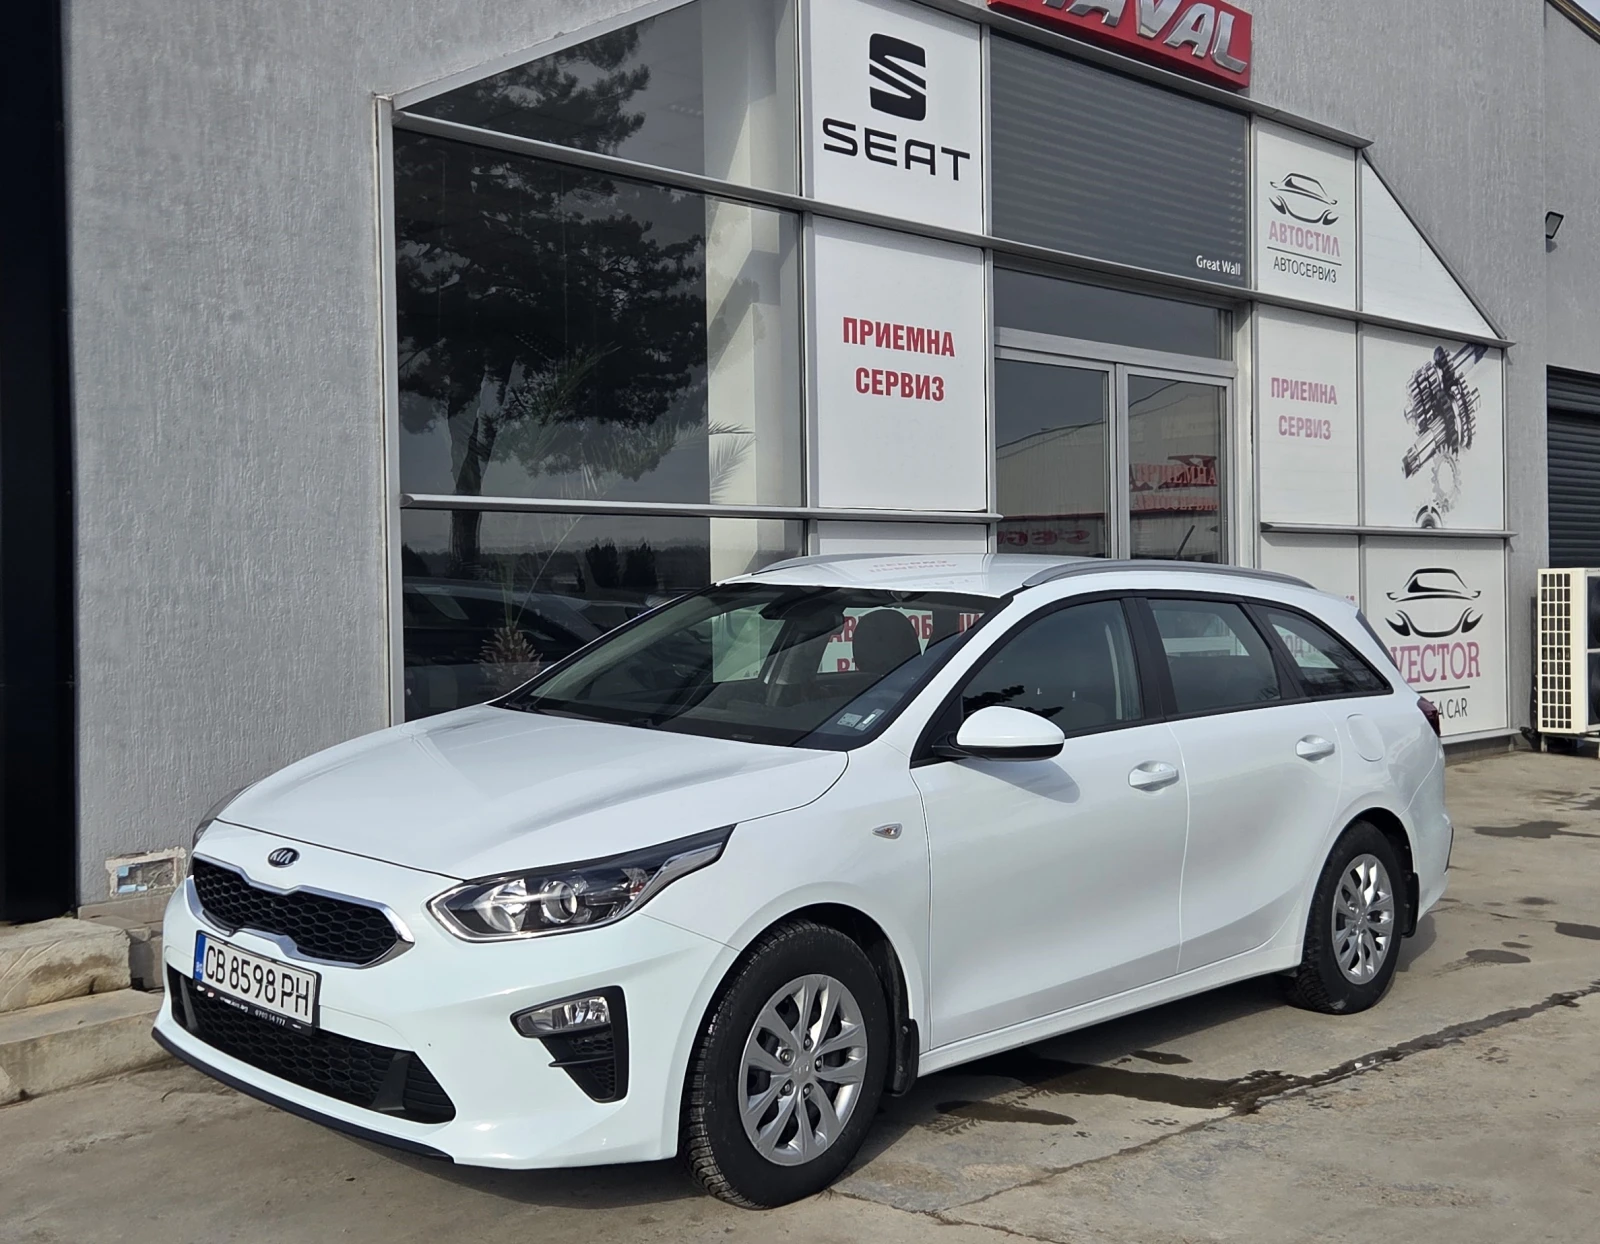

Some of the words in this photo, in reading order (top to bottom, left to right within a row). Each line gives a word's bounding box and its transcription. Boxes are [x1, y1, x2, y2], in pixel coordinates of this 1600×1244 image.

[822, 117, 971, 181] SEAT
[1269, 221, 1340, 257] АВТОСТИЛ
[1196, 255, 1220, 271] Great
[1222, 260, 1241, 275] Wall
[1273, 256, 1337, 283] АВТОСЕРВИЗ
[843, 316, 955, 357] ПРИЕМНА
[855, 366, 944, 401] СЕРВИЗ
[1271, 377, 1337, 405] ПРИЕМНА
[1279, 415, 1331, 440] СЕРВИЗ
[1391, 641, 1481, 683] VECTOR
[1446, 698, 1468, 719] CAR
[205, 945, 226, 985] CB
[229, 955, 277, 1004] 8598
[280, 972, 310, 1017] PH
